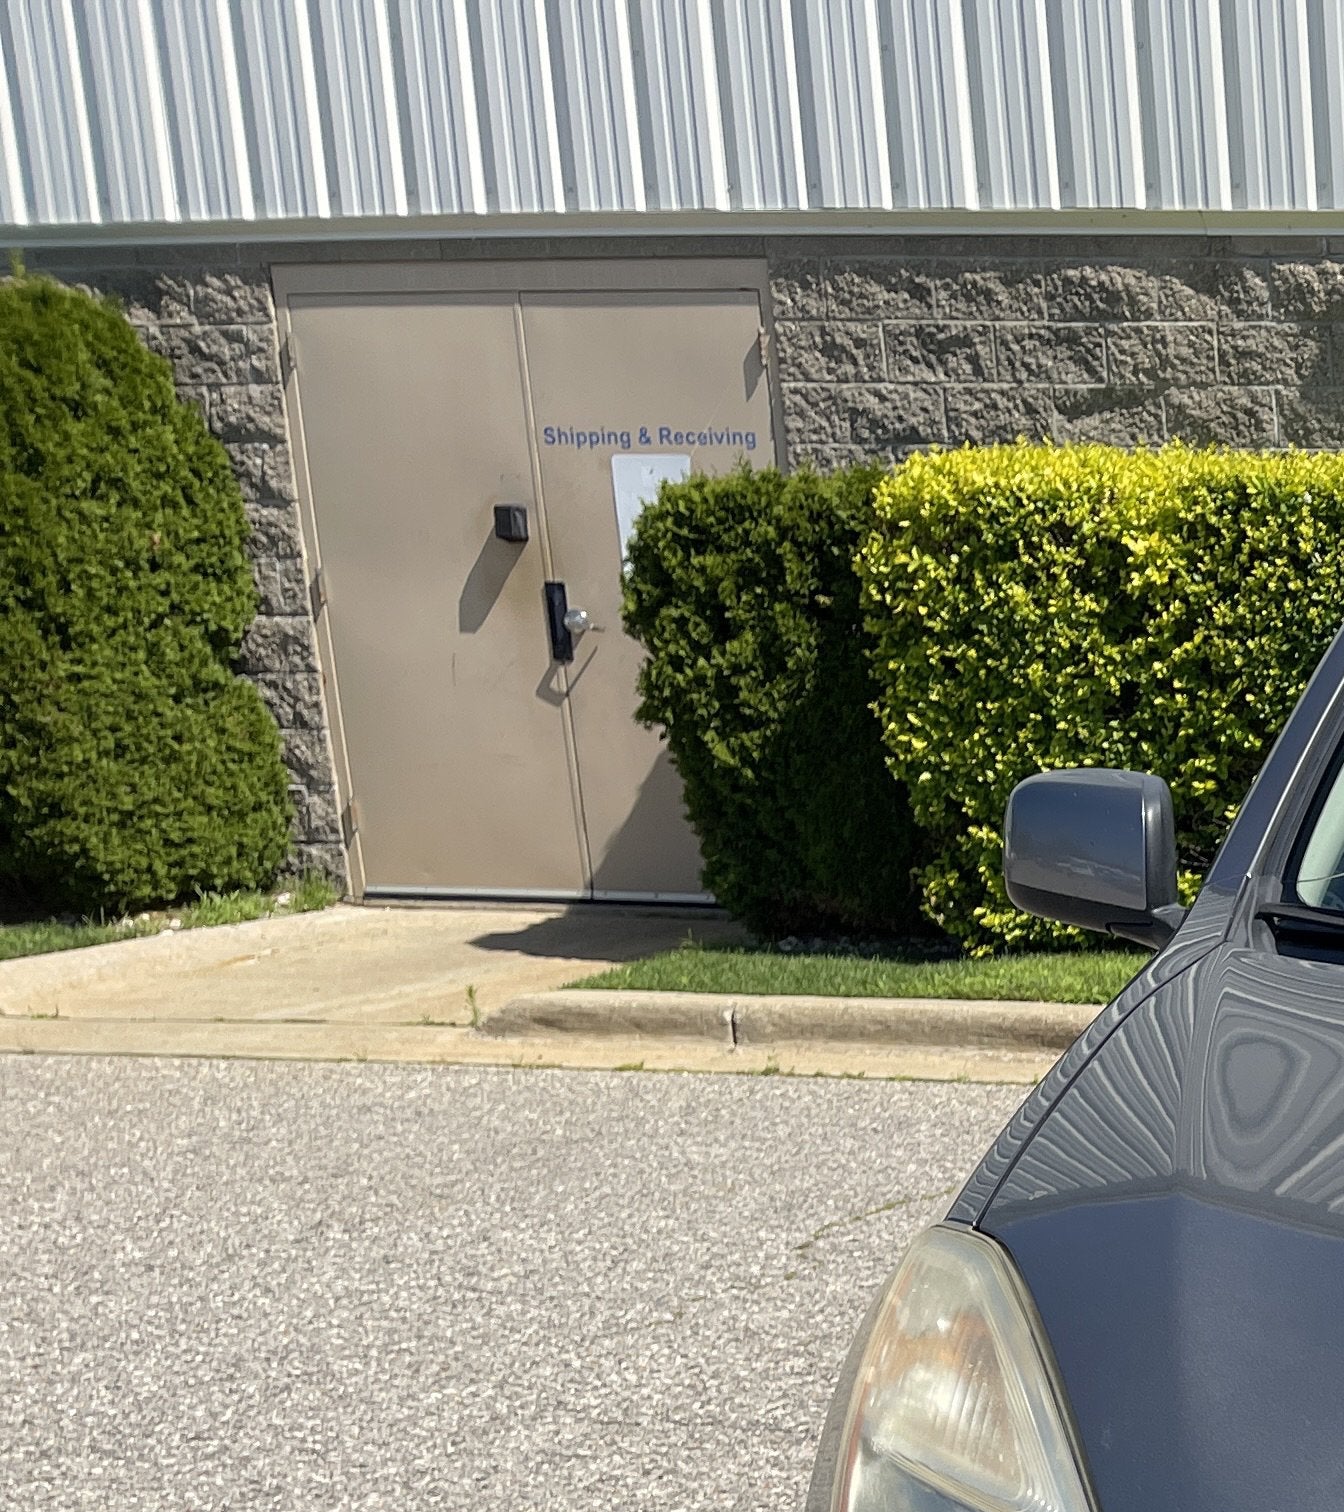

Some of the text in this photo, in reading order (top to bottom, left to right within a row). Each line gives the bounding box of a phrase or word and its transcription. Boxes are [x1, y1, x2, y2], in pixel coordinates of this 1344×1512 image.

[543, 426, 757, 449] Shipping & Receiving
